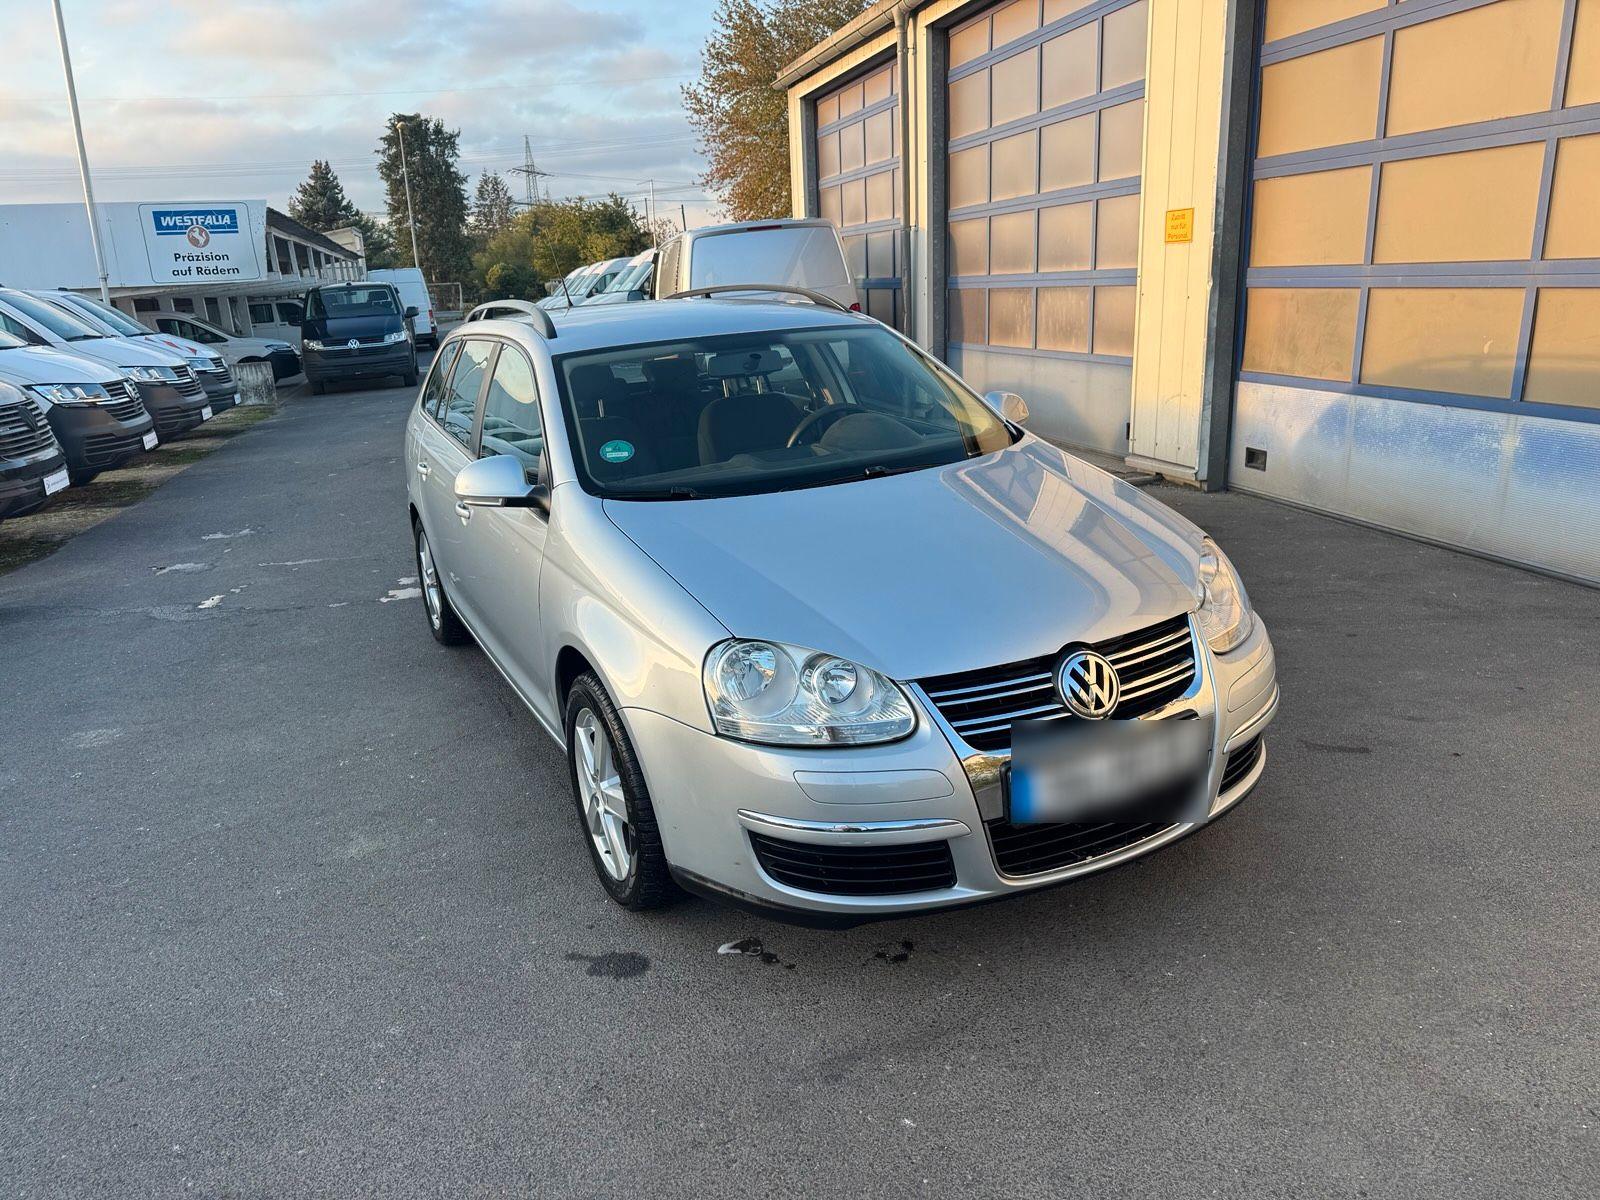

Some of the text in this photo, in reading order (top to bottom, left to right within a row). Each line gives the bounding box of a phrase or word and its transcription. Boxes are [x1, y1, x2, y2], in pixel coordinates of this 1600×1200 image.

[160, 215, 231, 226] WESTFALIA
[173, 252, 230, 262] Präzision
[172, 265, 240, 276] auf Rädern
[1061, 652, 1119, 716] VW
